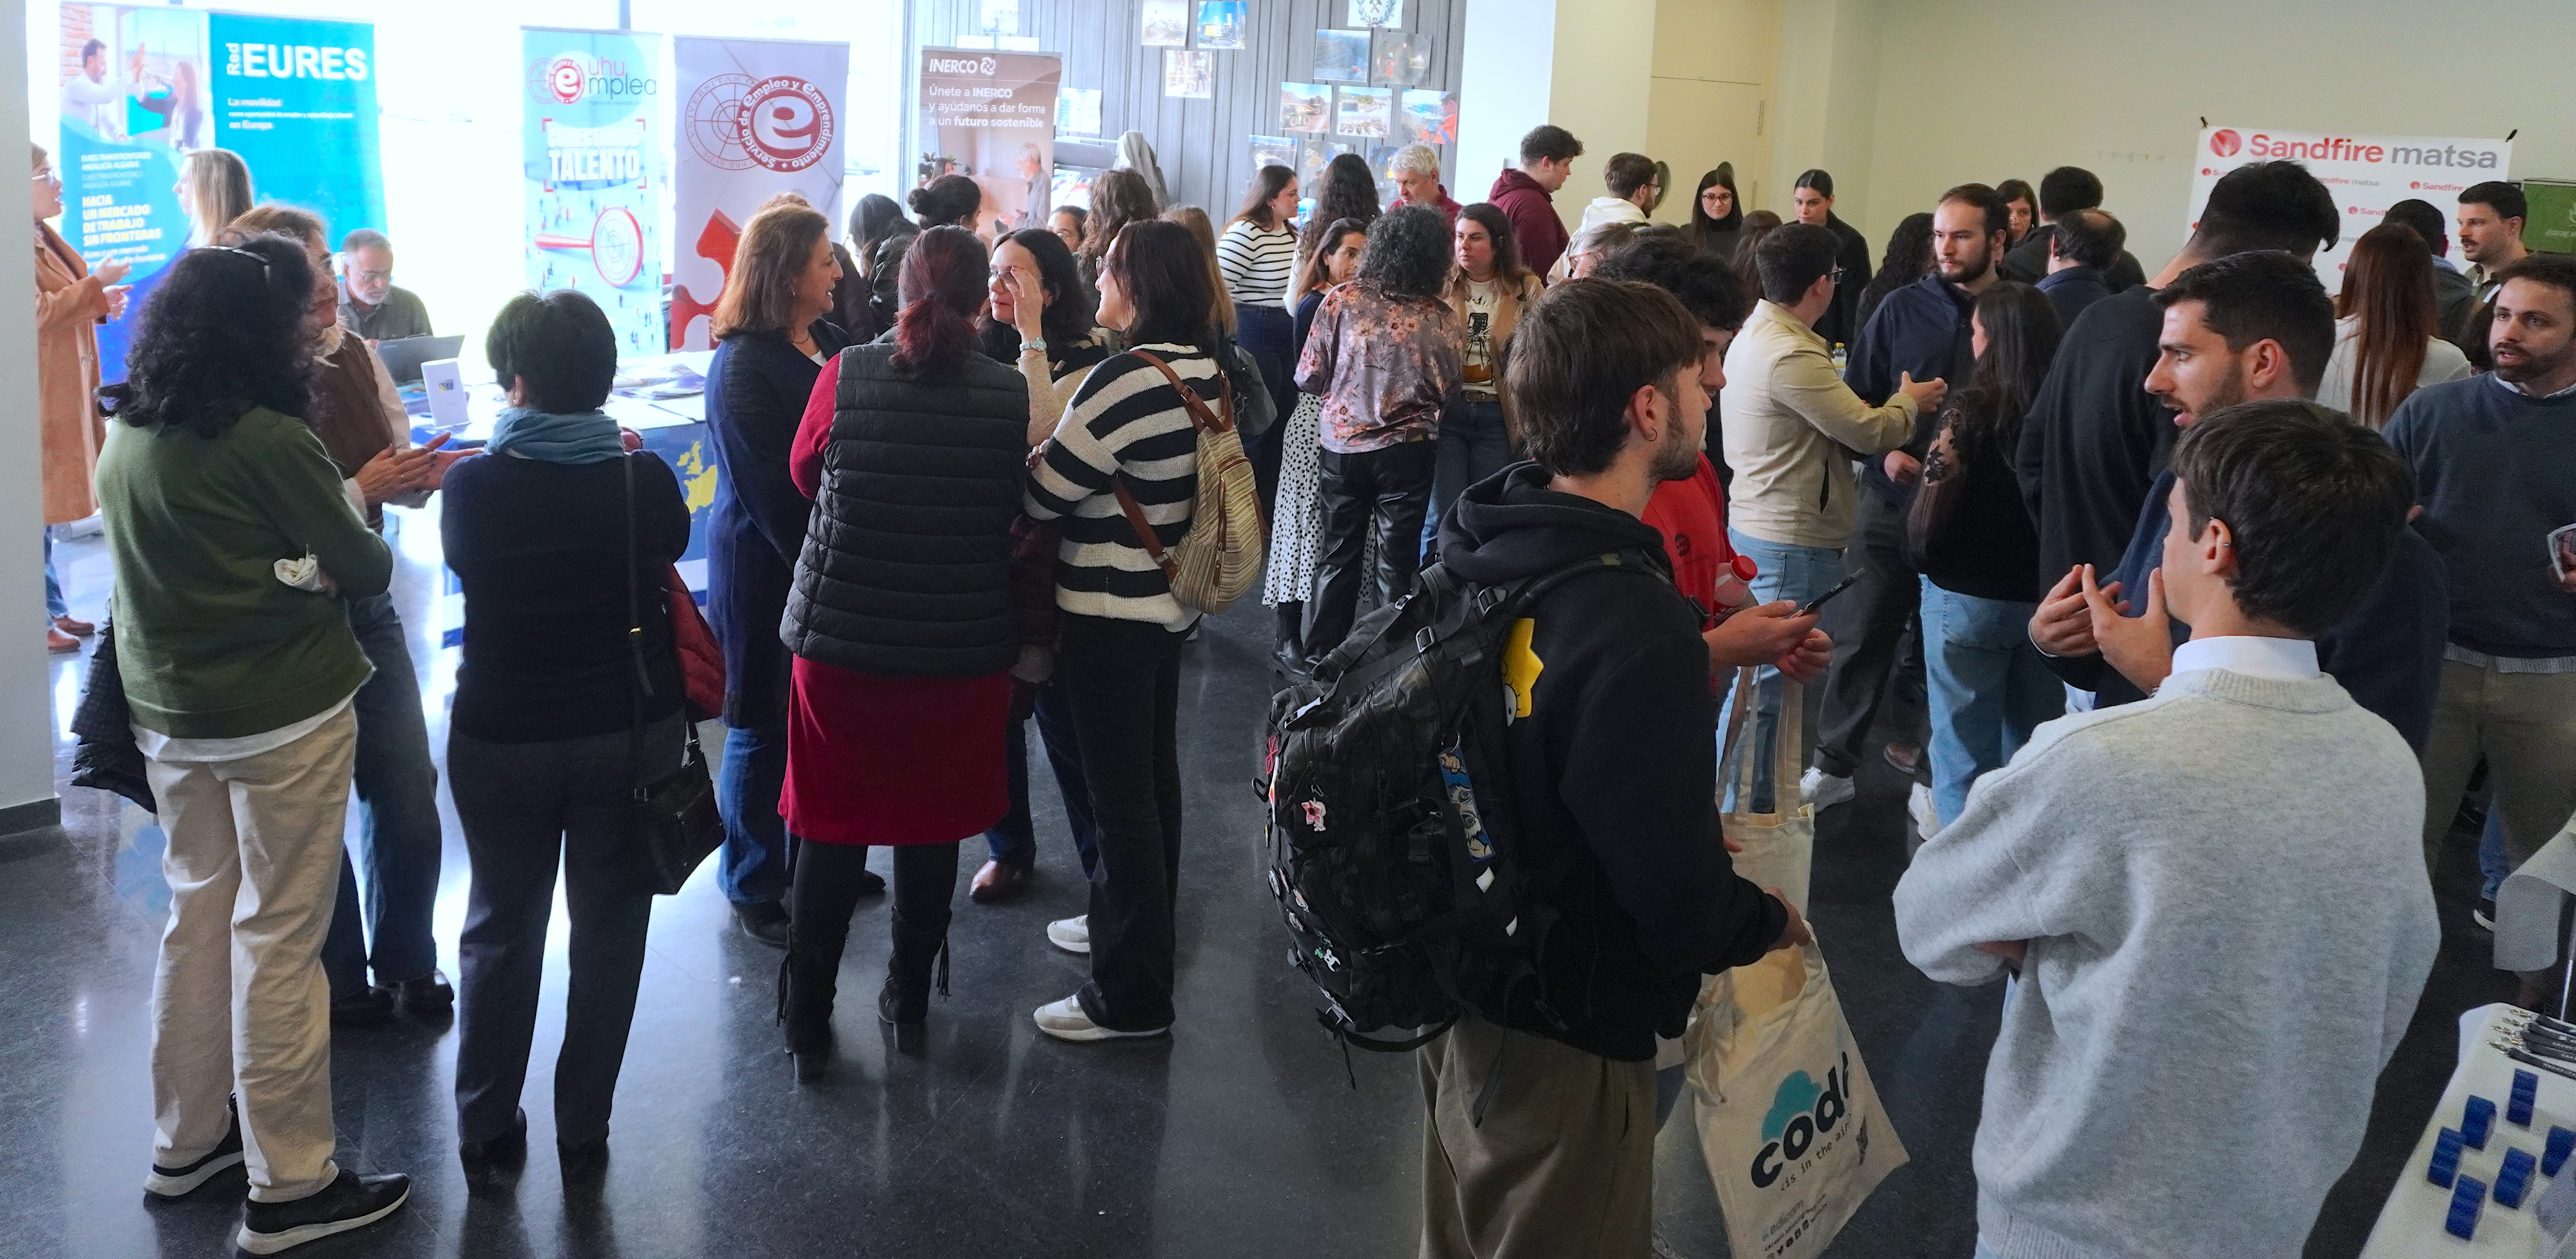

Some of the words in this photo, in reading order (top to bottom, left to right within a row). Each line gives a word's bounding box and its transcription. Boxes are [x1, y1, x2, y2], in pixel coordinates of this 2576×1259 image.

[226, 43, 240, 75] Red
[243, 43, 368, 80] EURES
[588, 56, 625, 76] uhu
[929, 58, 978, 74] INERCO
[792, 80, 800, 91] y
[929, 84, 961, 97] Únete
[973, 87, 1013, 98] INERCO
[241, 98, 282, 107] movilidad
[929, 103, 936, 113] y
[938, 101, 988, 113] ayúdanos
[999, 103, 1015, 113] dar
[1018, 103, 1045, 114] forma
[242, 120, 273, 131] Europa
[738, 110, 749, 126] de
[954, 116, 988, 127] futuro
[991, 117, 1044, 128] sostenible
[547, 130, 639, 148] CONECTAMOS
[741, 130, 776, 168] Servicio
[2249, 134, 2384, 164] Sandfire
[2390, 144, 2497, 169] matsa
[82, 161, 112, 171] ANDALUCÍA
[113, 160, 140, 169] ALGARVE
[548, 149, 639, 181] TALENTO
[2423, 182, 2464, 192] Sandfire
[82, 194, 113, 207] HACIA
[83, 208, 96, 220] UN
[99, 204, 150, 218] MERCADO
[83, 222, 96, 234] DE
[98, 217, 144, 231] TRABAJO
[84, 234, 99, 246] SIN
[100, 228, 162, 244] FRONTERAS
[1816, 1142, 1832, 1159] the
